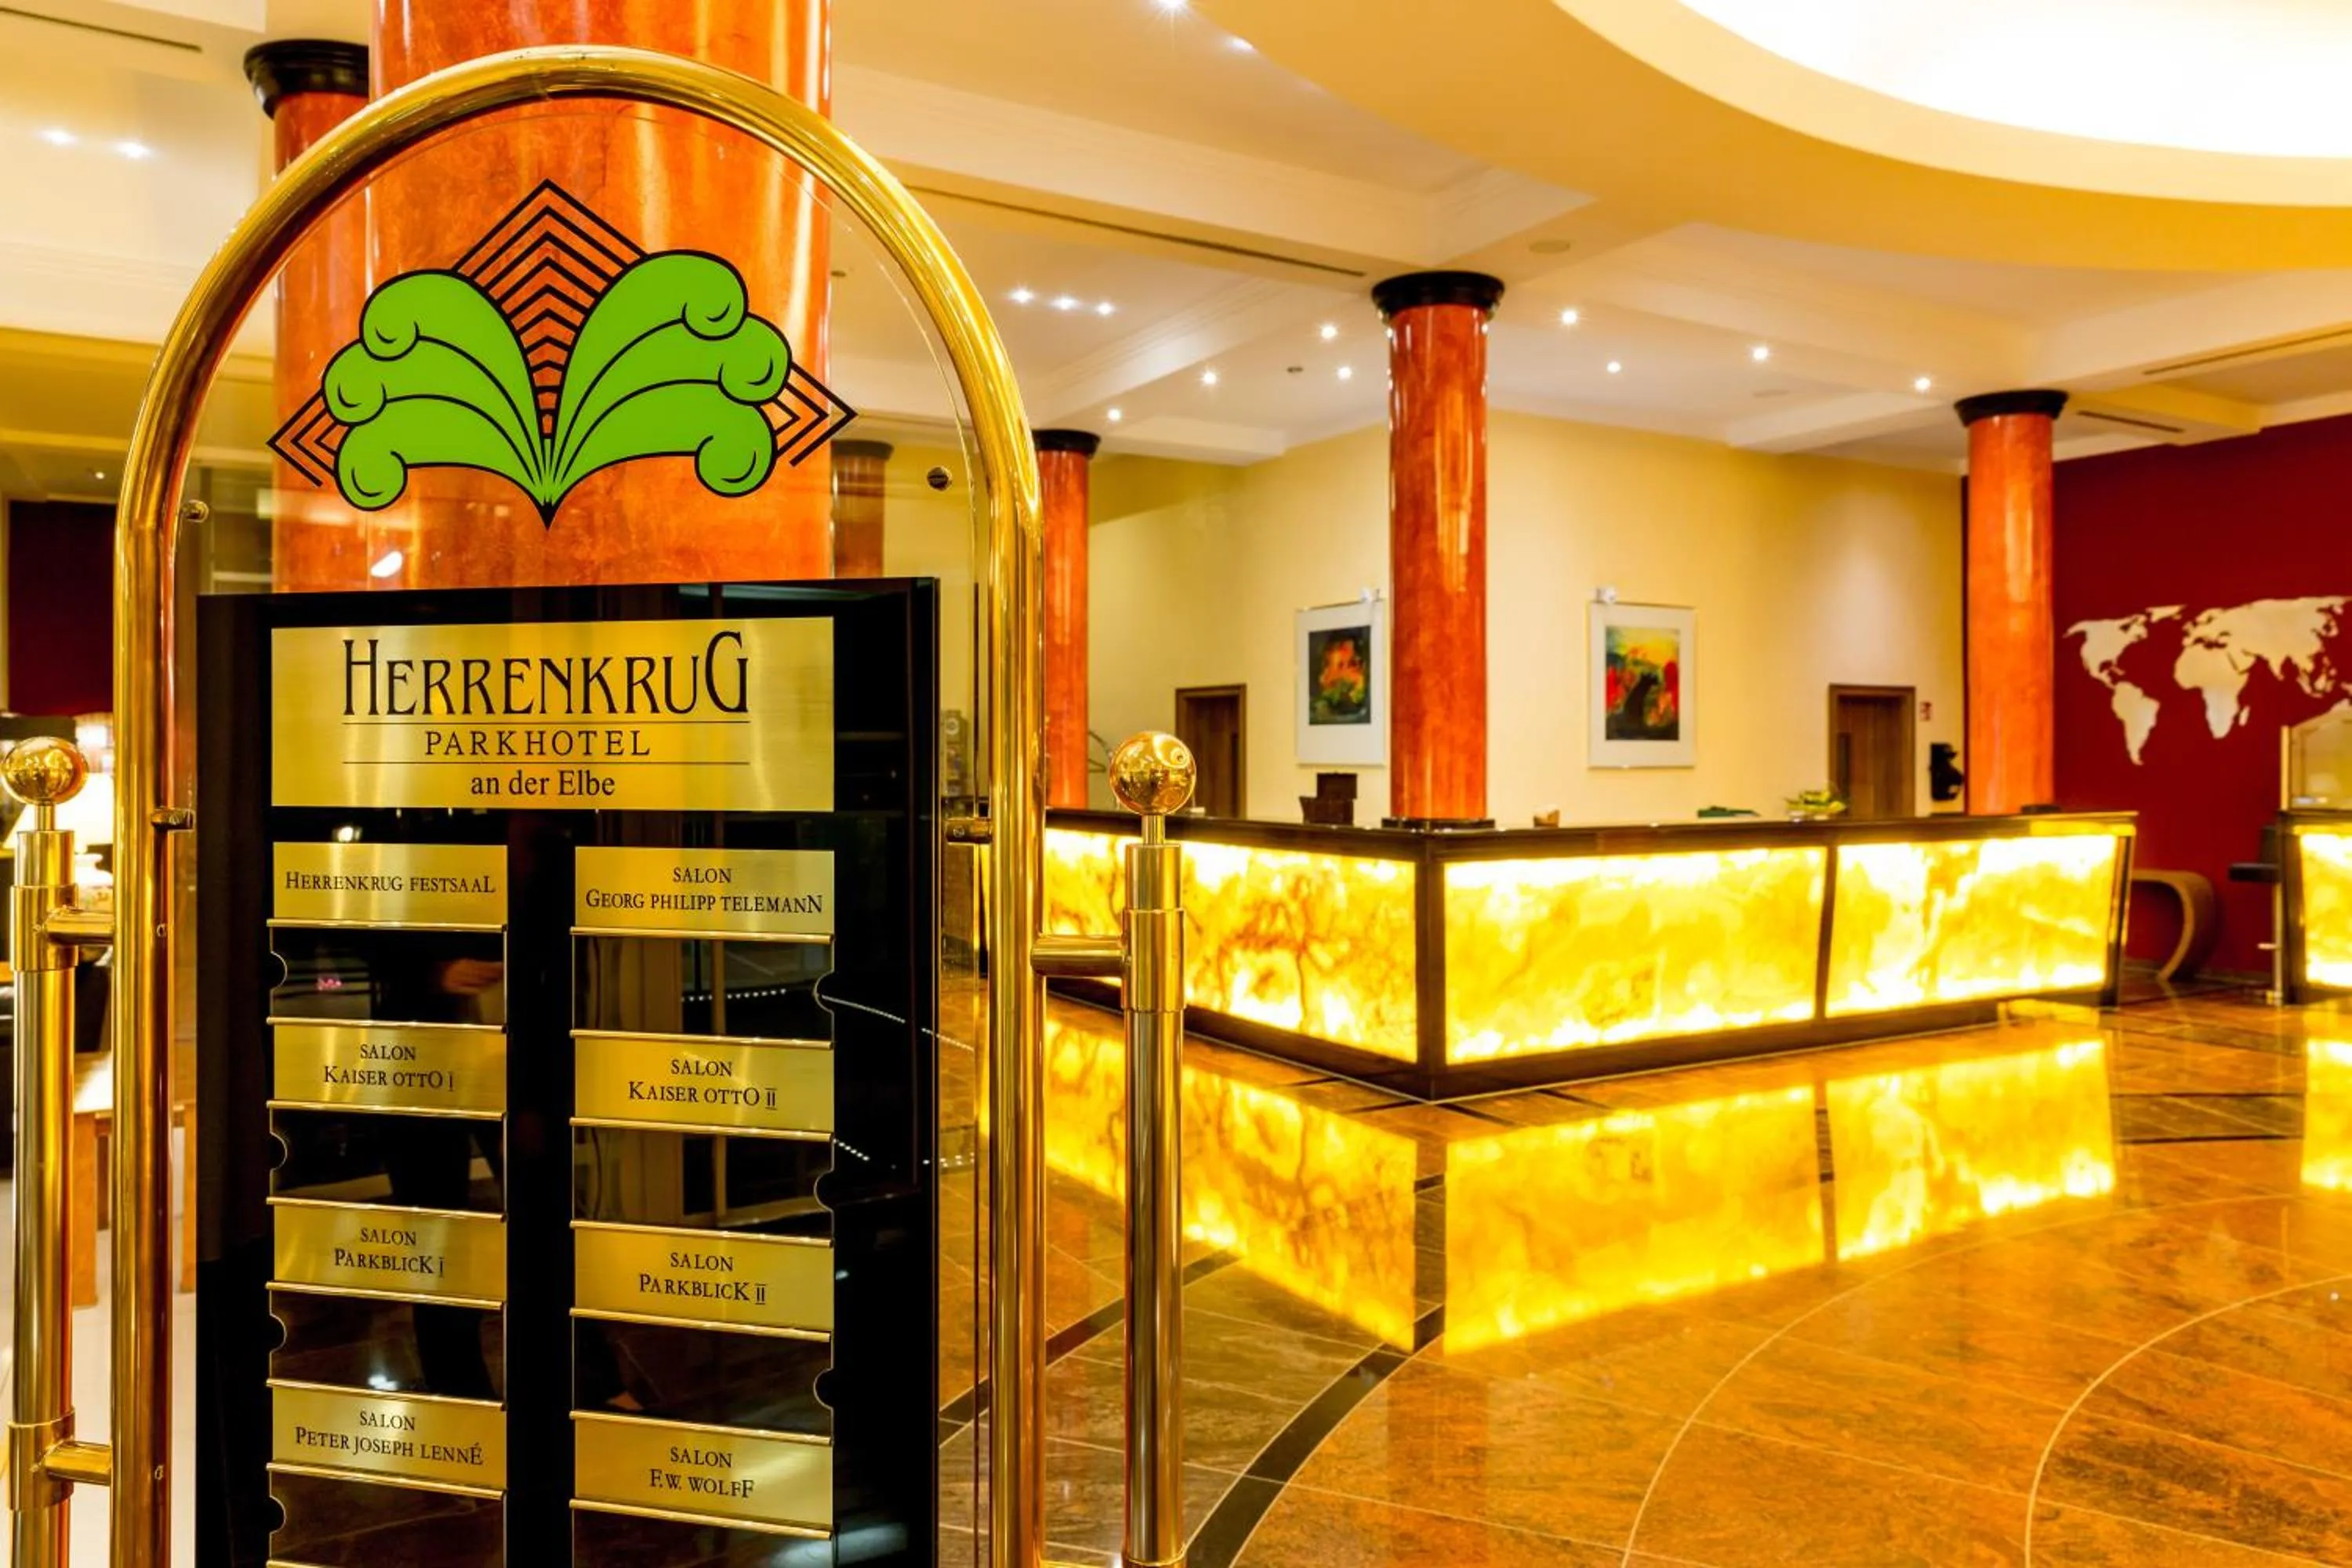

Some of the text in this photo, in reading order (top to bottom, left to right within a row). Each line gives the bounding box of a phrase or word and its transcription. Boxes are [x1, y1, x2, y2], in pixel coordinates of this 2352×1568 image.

[343, 630, 749, 716] HERRENKRUG
[425, 730, 650, 757] PARKHOTEL
[470, 769, 615, 797] an der Elbe
[286, 871, 495, 893] HERRENKRUG FESTSAAL
[673, 867, 731, 884] SALON
[586, 888, 822, 914] GEORG PHILIPP TELEMANN
[360, 1044, 416, 1061] SALON
[323, 1065, 388, 1086] KAISER
[392, 1070, 444, 1088] OTTO
[671, 1059, 732, 1077] SALON
[629, 1080, 699, 1103] KAISER
[703, 1087, 760, 1106] OTTO
[360, 1228, 416, 1247] SALON
[334, 1247, 434, 1274] PARKBLICK
[670, 1252, 733, 1272] SALON
[640, 1273, 750, 1301] PARKBLICK
[359, 1410, 416, 1431] SALON
[296, 1426, 483, 1465] PETER JOSEPH LENNÉ
[670, 1446, 731, 1468] SALON
[688, 1476, 754, 1498] WOLFF
